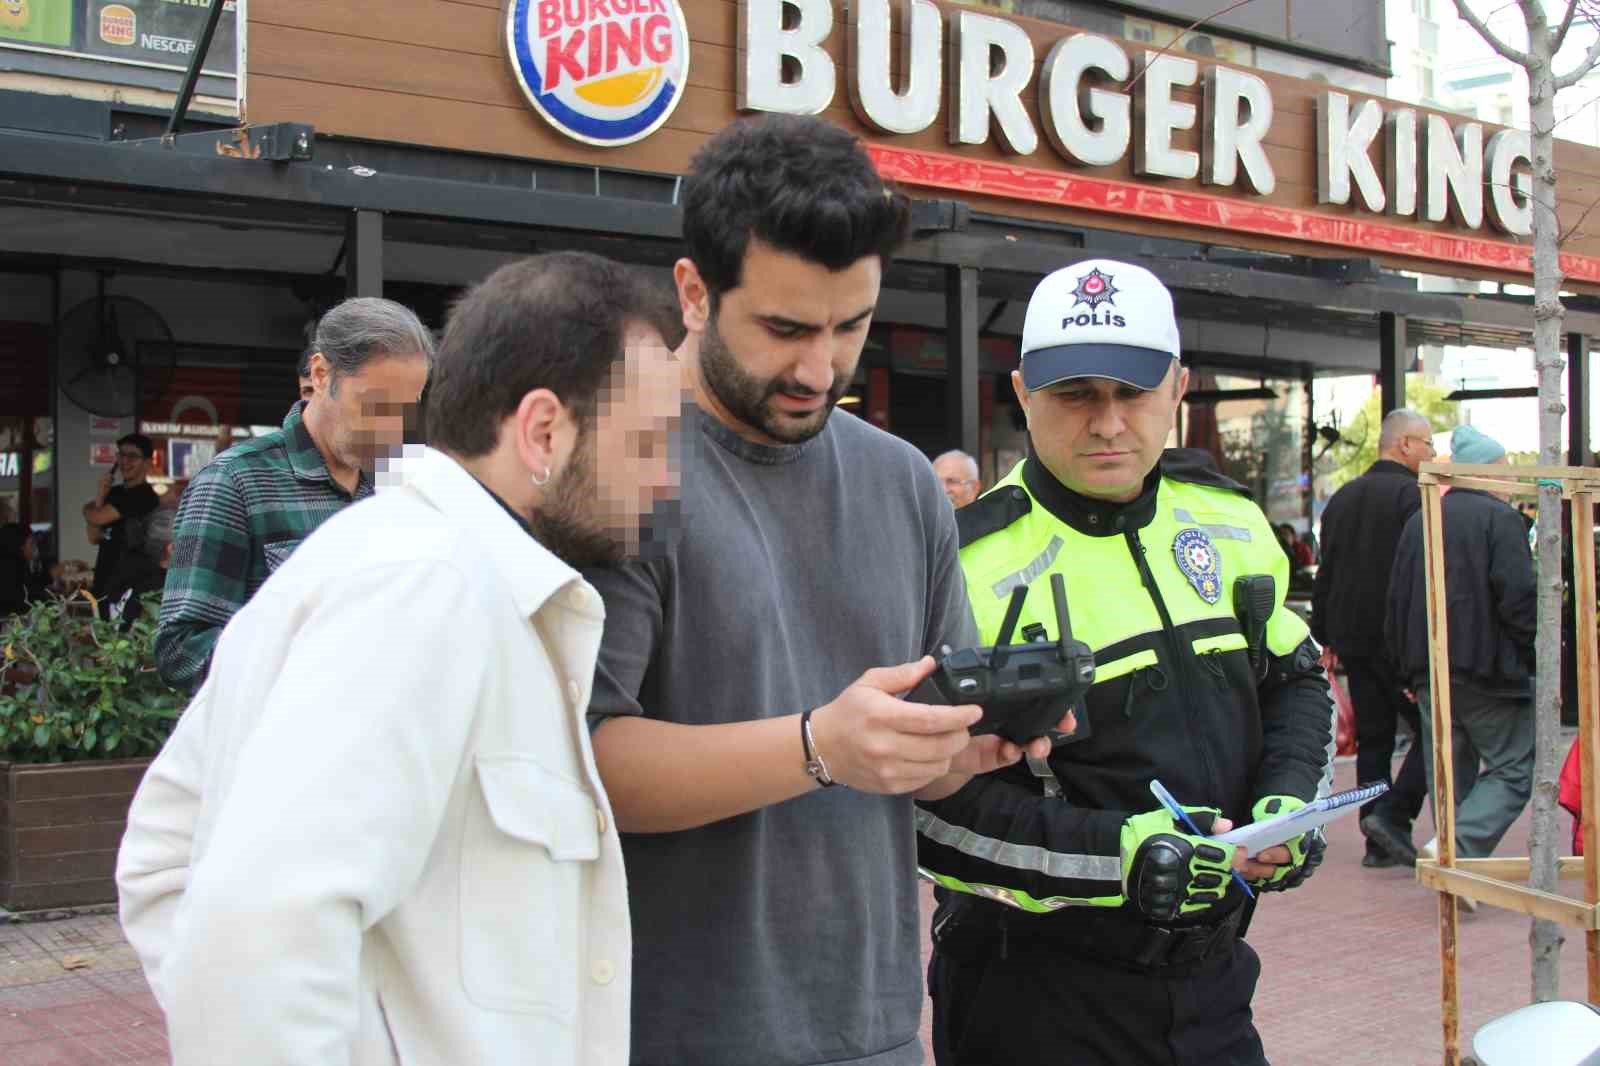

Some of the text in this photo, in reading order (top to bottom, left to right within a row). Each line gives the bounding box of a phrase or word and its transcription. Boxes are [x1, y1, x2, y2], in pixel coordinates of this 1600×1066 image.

[141, 33, 196, 54] NESCAF
[544, 14, 673, 91] KING
[743, 0, 1535, 236] BURGER KING
